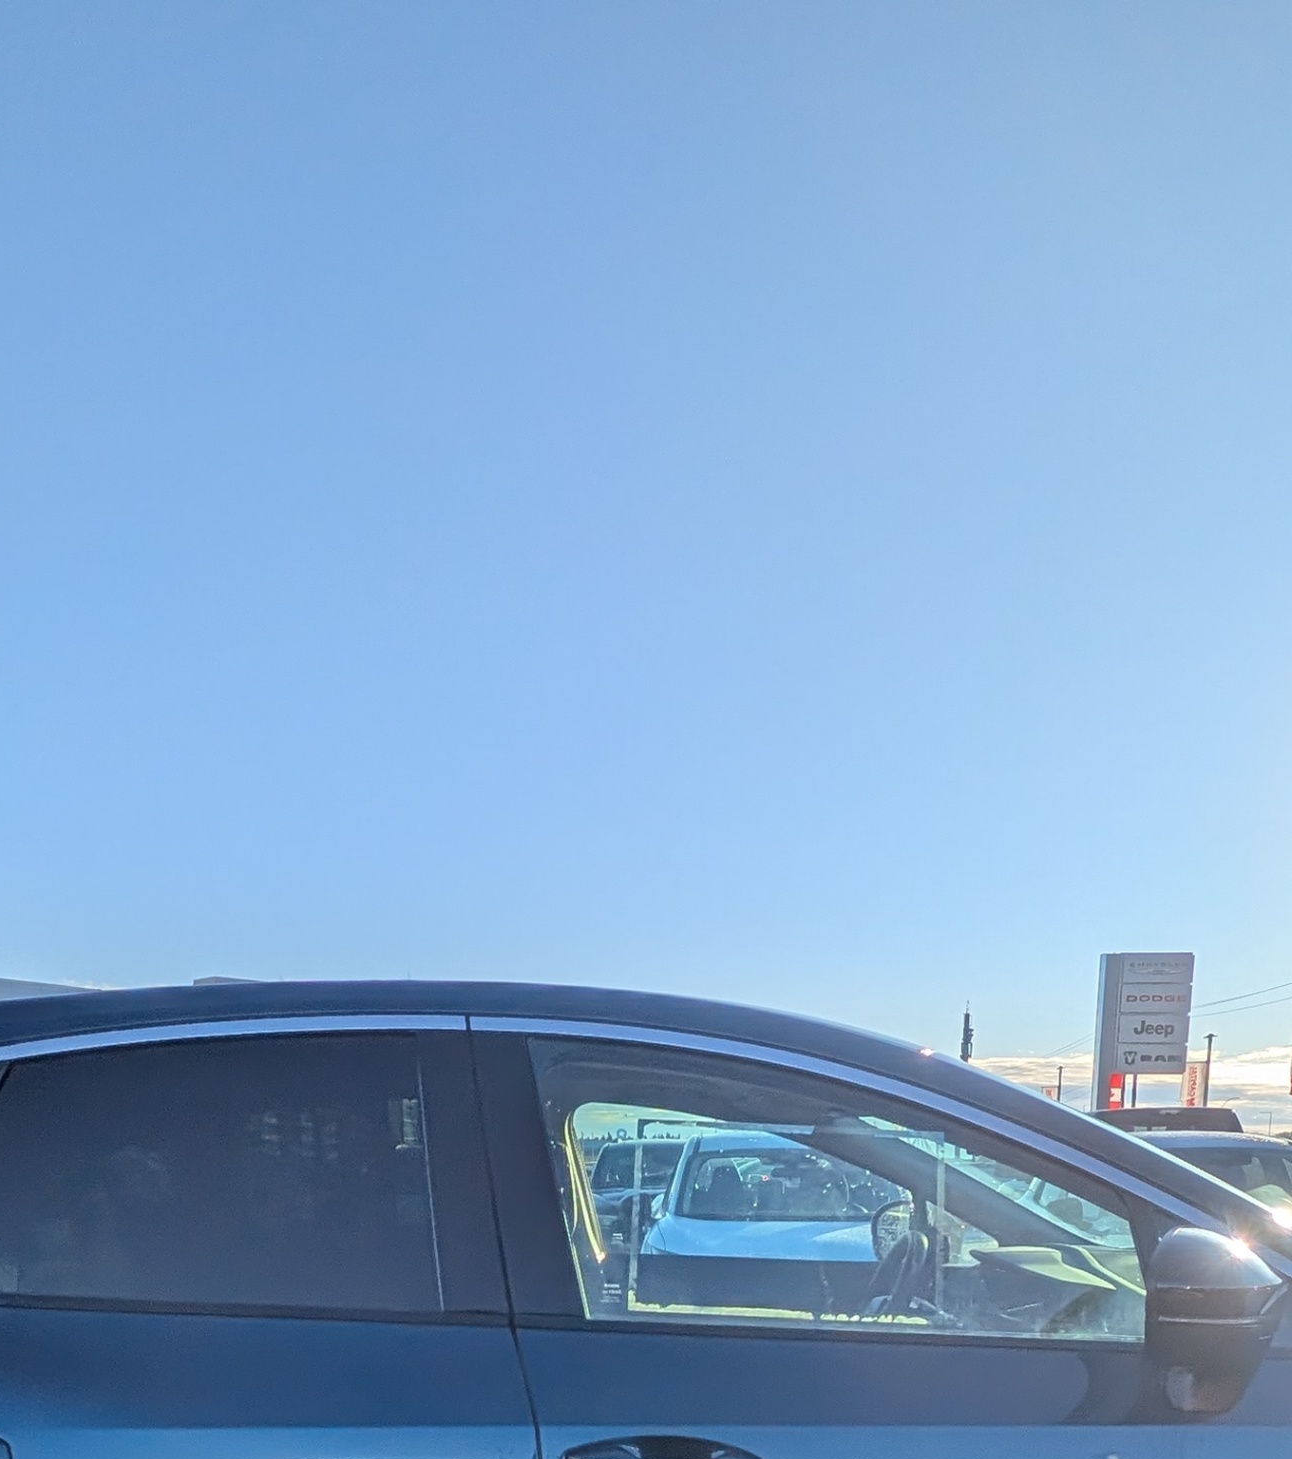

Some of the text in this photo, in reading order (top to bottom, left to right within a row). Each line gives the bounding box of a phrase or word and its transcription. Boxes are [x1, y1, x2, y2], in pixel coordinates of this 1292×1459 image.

[1126, 995, 1187, 1003] DODGE
[1133, 1020, 1175, 1038] Jeep
[1140, 1054, 1183, 1063] RAM
